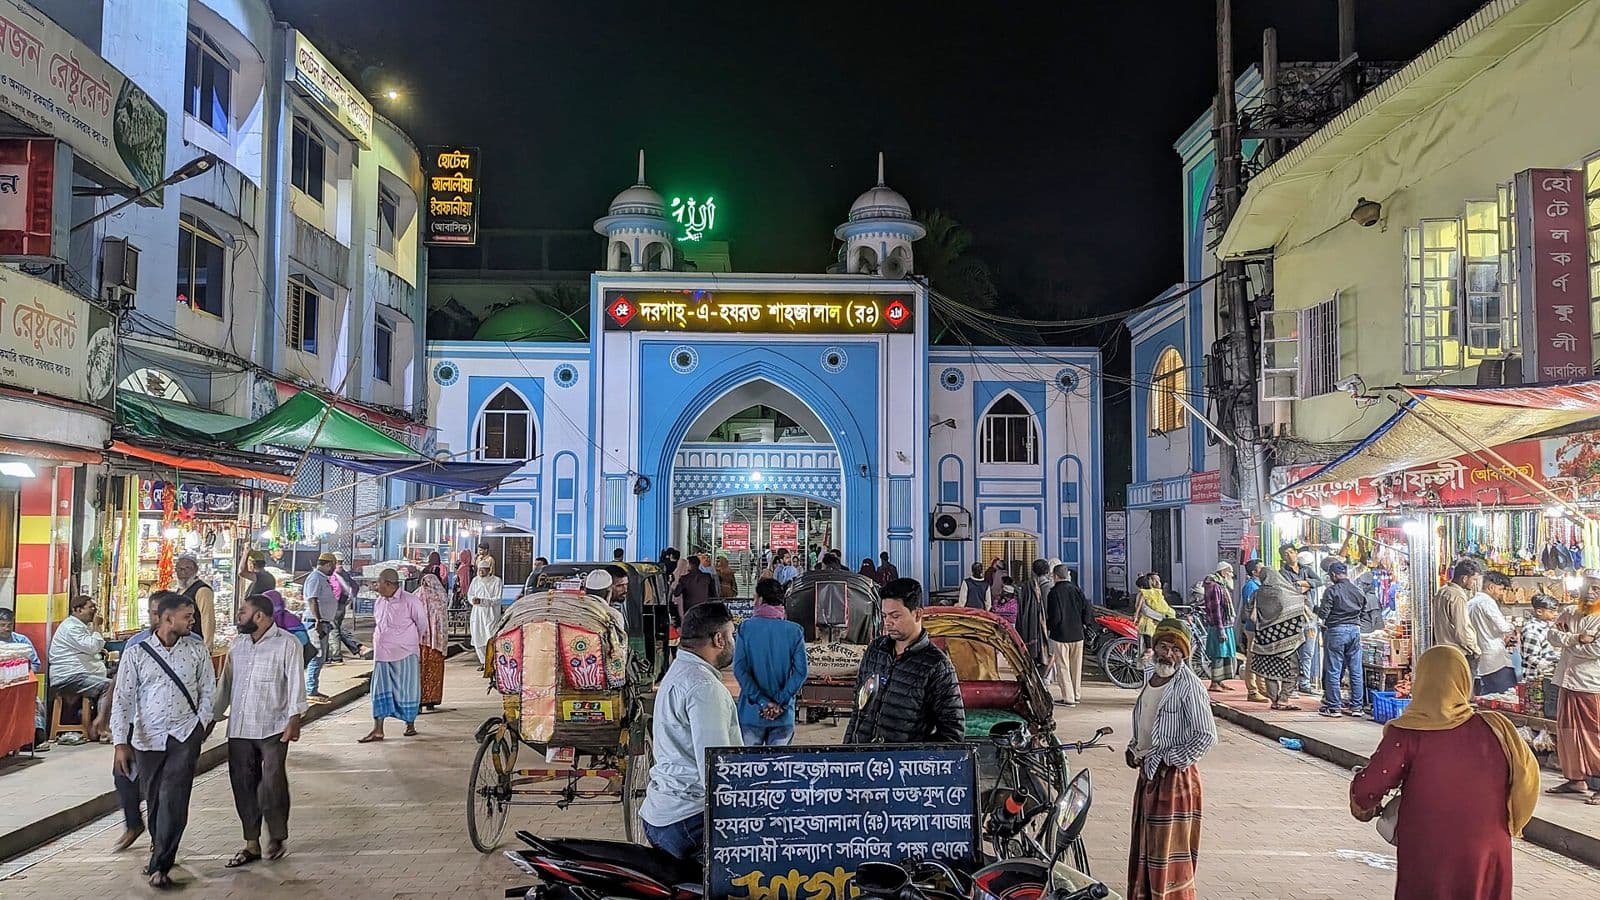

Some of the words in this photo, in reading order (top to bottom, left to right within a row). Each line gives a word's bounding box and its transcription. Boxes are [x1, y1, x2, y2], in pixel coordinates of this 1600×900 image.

[437, 150, 470, 169] হোটেল
[431, 172, 473, 193] জালালীয়া
[430, 196, 472, 217] ইরফানীয়া
[431, 221, 472, 234] (আবাসিক)
[1542, 362, 1587, 378] আবাসিক
[715, 757, 770, 782] হযরত
[772, 760, 864, 780] শাহজালাল
[867, 758, 894, 781] (রঃ)
[899, 758, 956, 777] মাজার
[713, 784, 787, 810] জিয়ারতে
[791, 786, 843, 806] আগত
[845, 788, 890, 804] সকল
[714, 817, 766, 839] হযরত
[769, 815, 862, 836] শাহজালাল
[863, 811, 889, 834] (রঃ)
[889, 814, 930, 832] দরগা
[931, 814, 973, 831] বাজার
[714, 837, 778, 864] ব্যবসায়ী
[780, 843, 833, 863] কল্যাণ
[836, 837, 892, 859] সমিতির
[931, 841, 970, 860] থেকে
